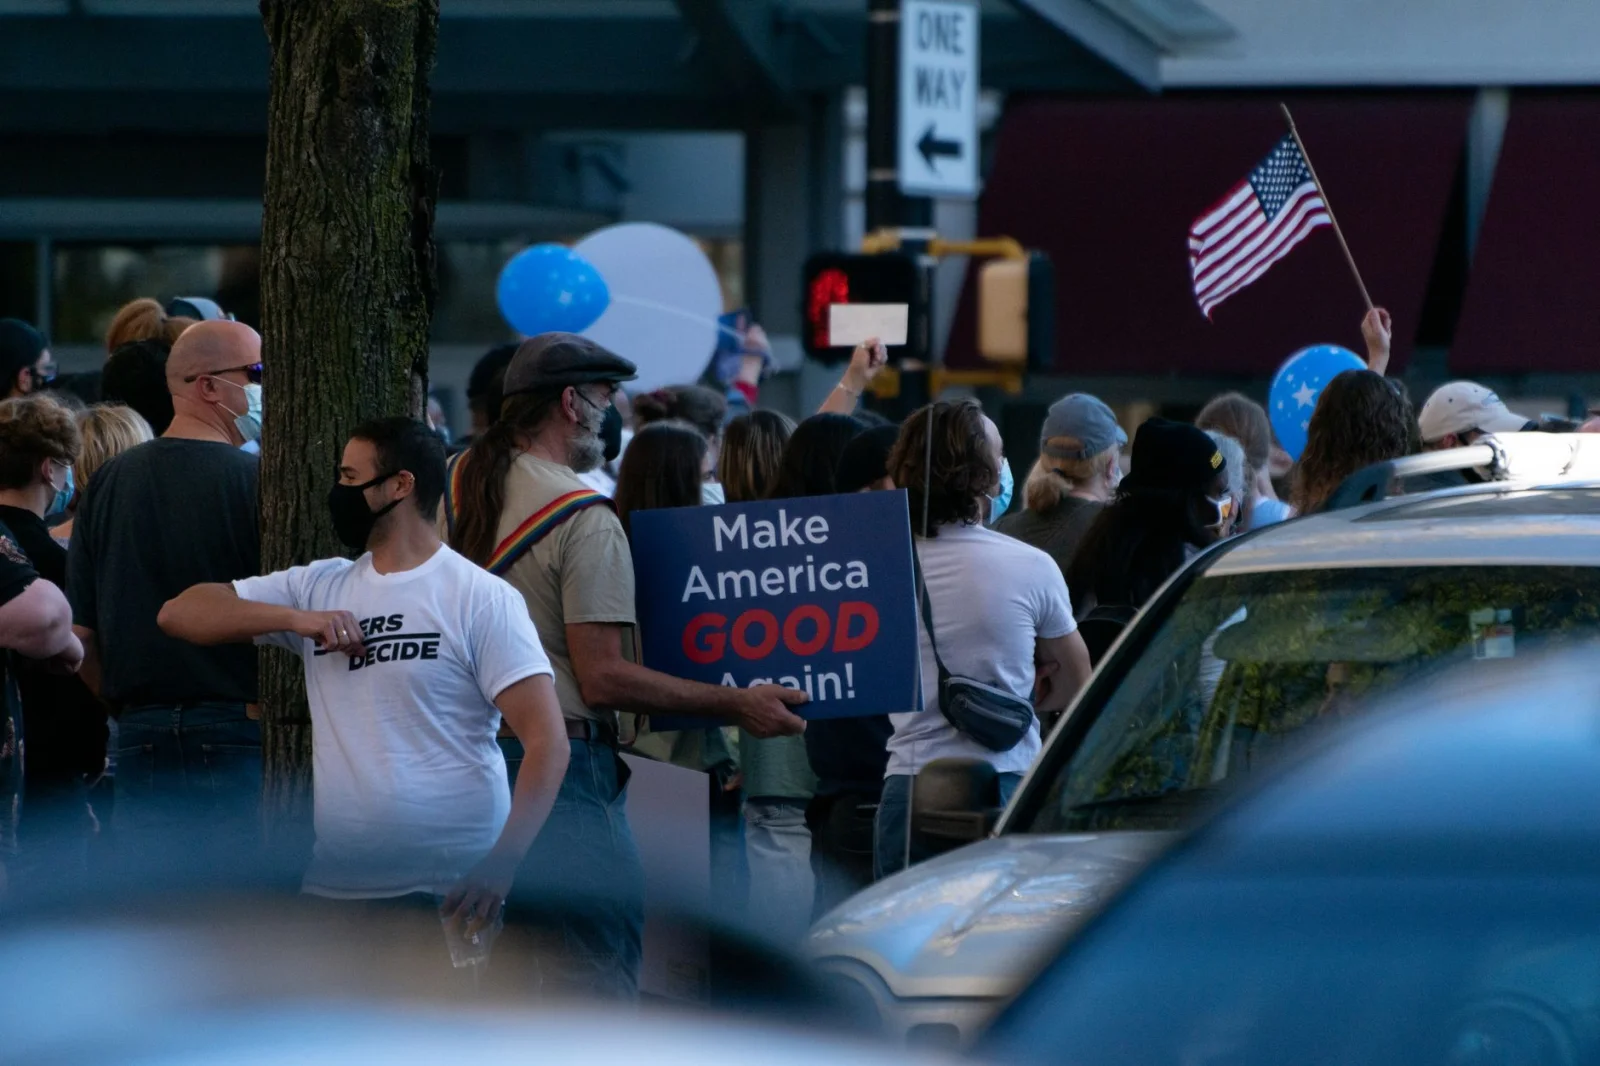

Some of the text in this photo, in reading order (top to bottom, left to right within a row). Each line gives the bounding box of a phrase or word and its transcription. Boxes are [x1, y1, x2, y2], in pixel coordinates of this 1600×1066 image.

[917, 10, 966, 55] ONE
[915, 65, 967, 112] WAY
[712, 509, 830, 551] Make
[681, 555, 869, 602] America
[681, 601, 880, 664] GOOD
[349, 641, 439, 671] DECIDE
[720, 662, 856, 702] ain!
